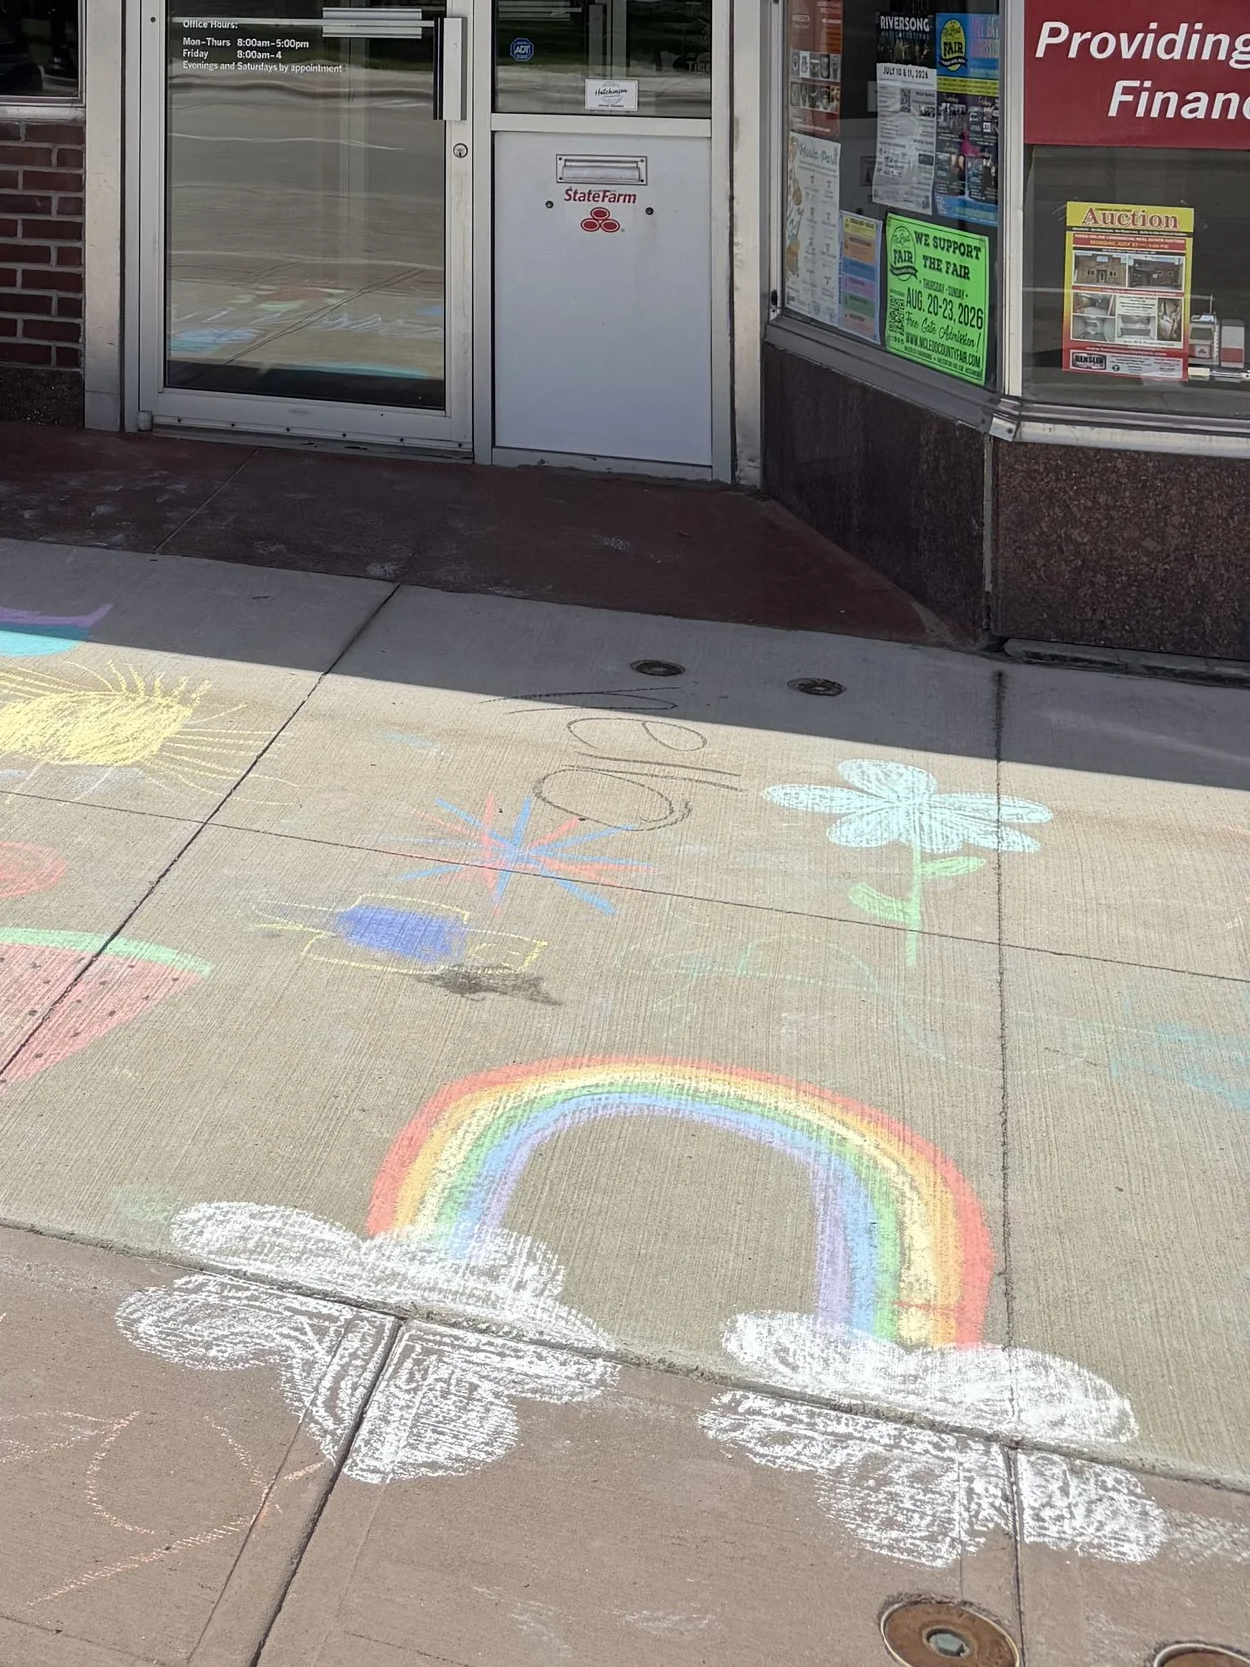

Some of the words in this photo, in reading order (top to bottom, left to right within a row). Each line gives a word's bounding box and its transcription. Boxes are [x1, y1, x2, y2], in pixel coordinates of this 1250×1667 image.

[182, 20, 208, 29] Office
[210, 20, 238, 29] Hours:
[880, 15, 930, 32] RIVERSONG
[182, 48, 209, 60] Friday
[943, 41, 963, 57] FAIR
[1034, 21, 1250, 70] Providing
[182, 60, 218, 71] Evenings
[219, 61, 235, 70] and
[237, 62, 277, 73] Saturdays
[278, 62, 288, 73] by
[290, 63, 342, 74] appointment
[1081, 207, 1179, 230] Auction
[914, 230, 930, 248] WE
[932, 235, 982, 261] SUPPORT
[893, 248, 914, 266] FAIR
[922, 254, 943, 273] THE
[945, 260, 971, 281] FAIR
[906, 286, 925, 312] AUG.
[927, 293, 956, 325] 20-23,
[958, 302, 984, 330] 2026
[905, 310, 919, 329] Free
[921, 317, 937, 335] Gate
